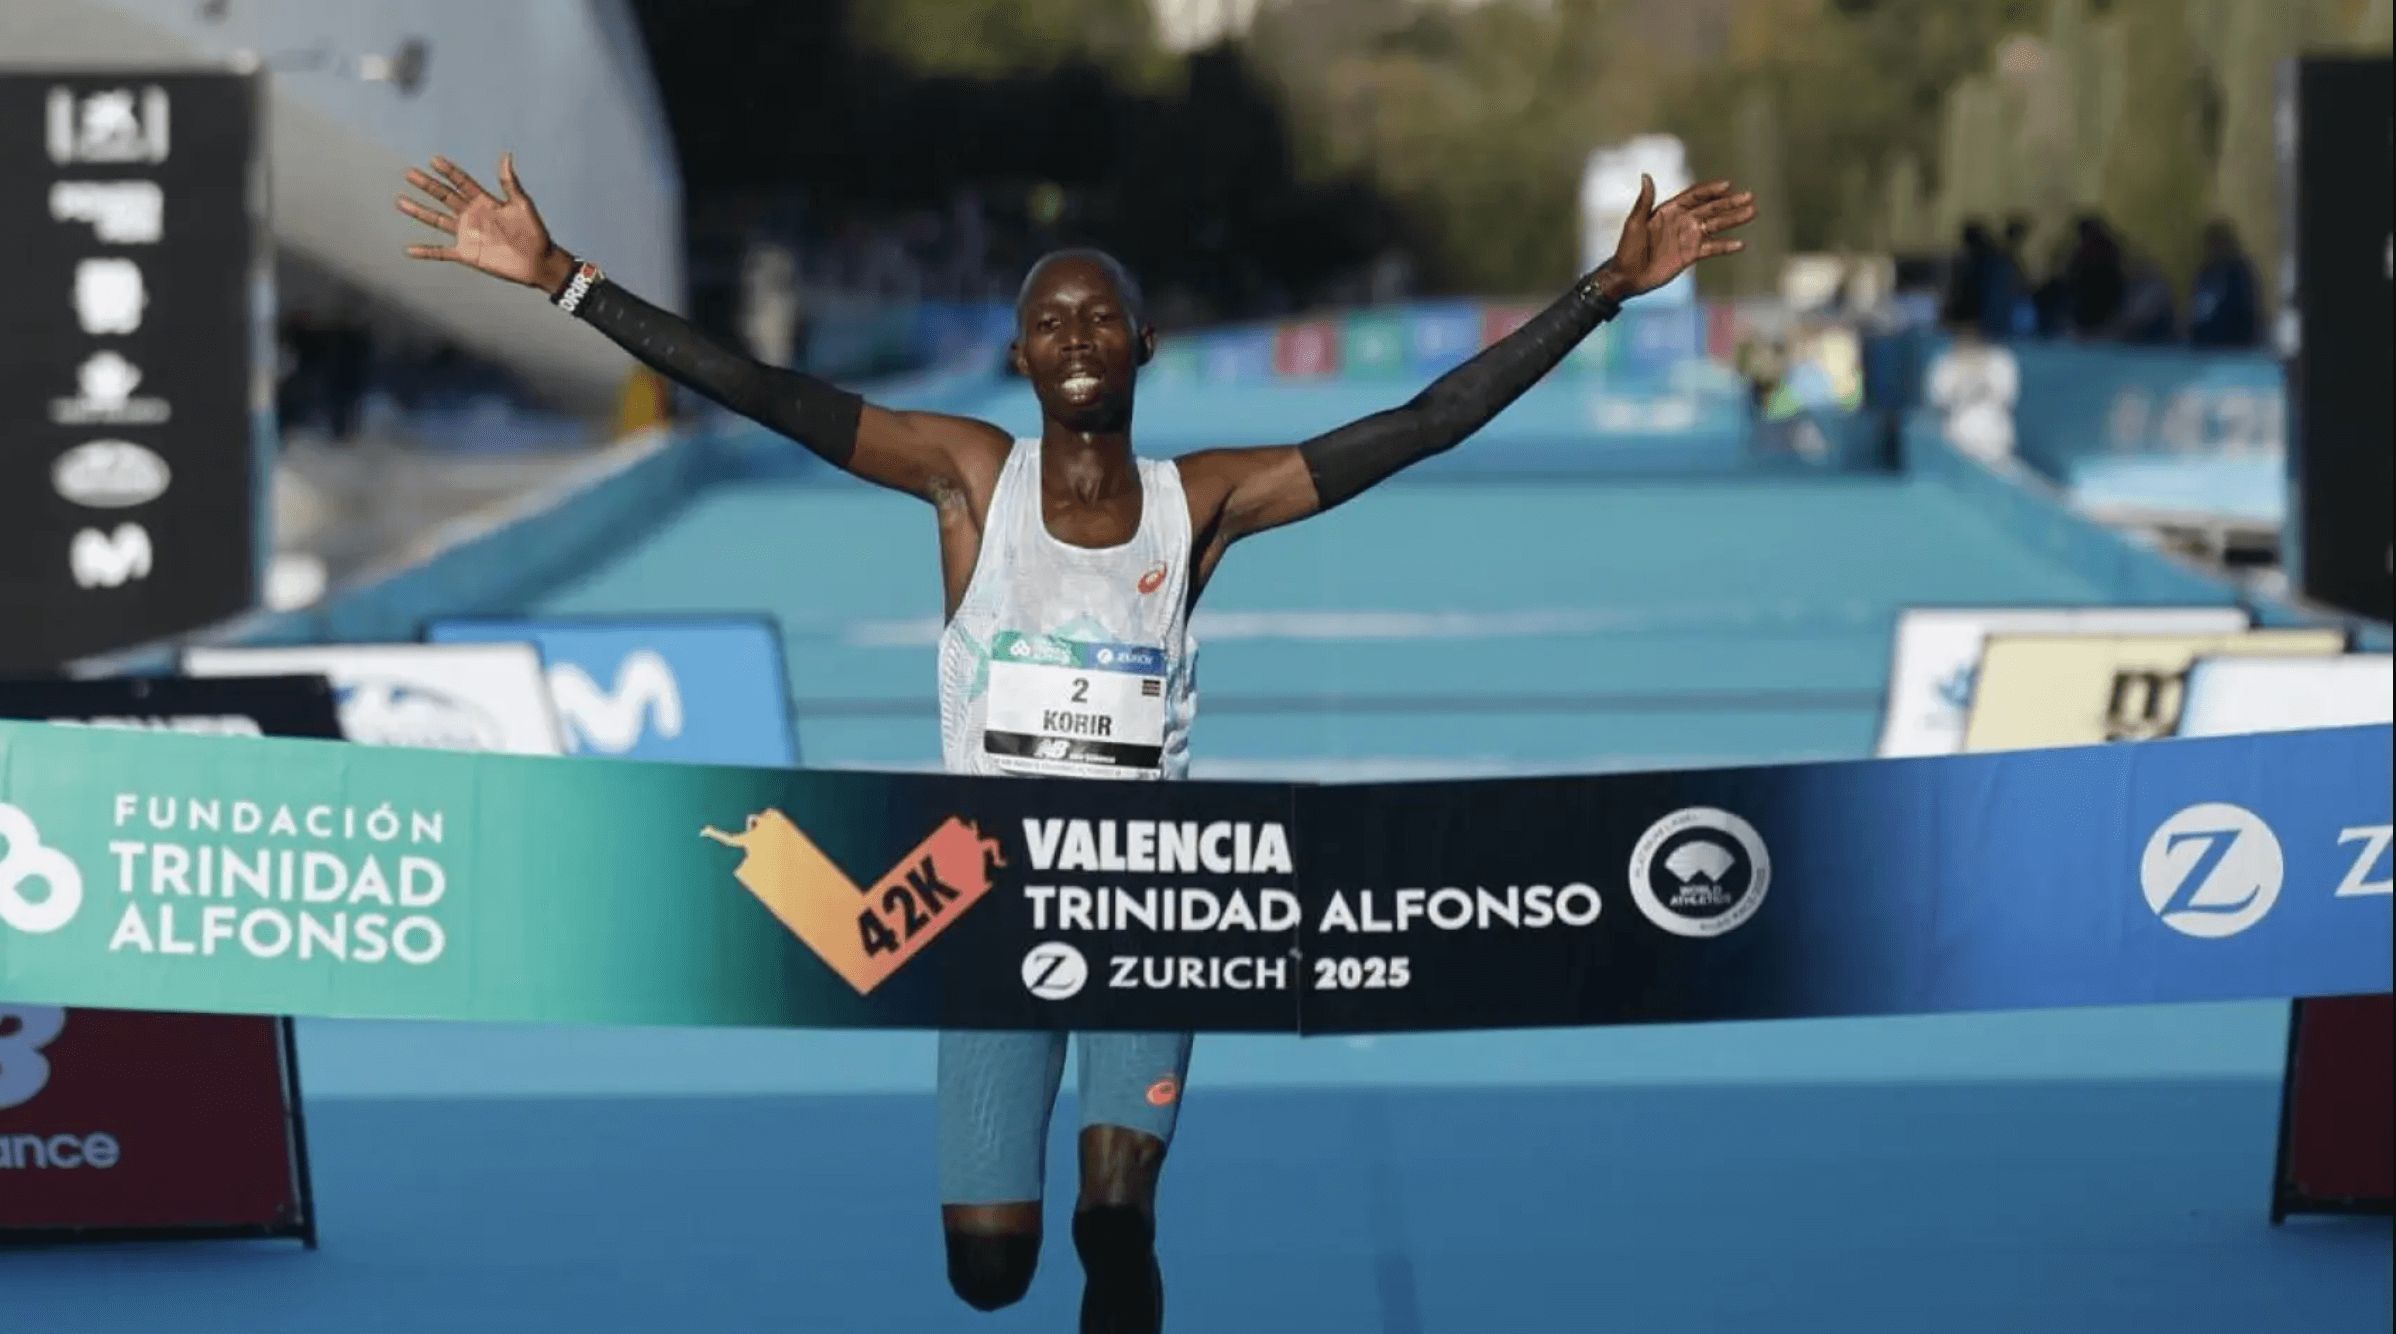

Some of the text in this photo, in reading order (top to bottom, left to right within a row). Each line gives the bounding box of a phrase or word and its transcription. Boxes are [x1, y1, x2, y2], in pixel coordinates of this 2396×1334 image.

[1071, 677, 1090, 704] 2
[1043, 708, 1113, 737] KORIR
[114, 793, 443, 845] FUNDACIÓN
[1022, 817, 1293, 874] VALENCIA
[109, 840, 446, 908] TRINIDAD
[858, 853, 962, 957] 42K
[1023, 882, 1603, 933] TRINIDAD ALFONSO
[108, 900, 446, 965] ALFONSO
[1109, 955, 1287, 990] ZURICH
[1314, 955, 1411, 990] 2025
